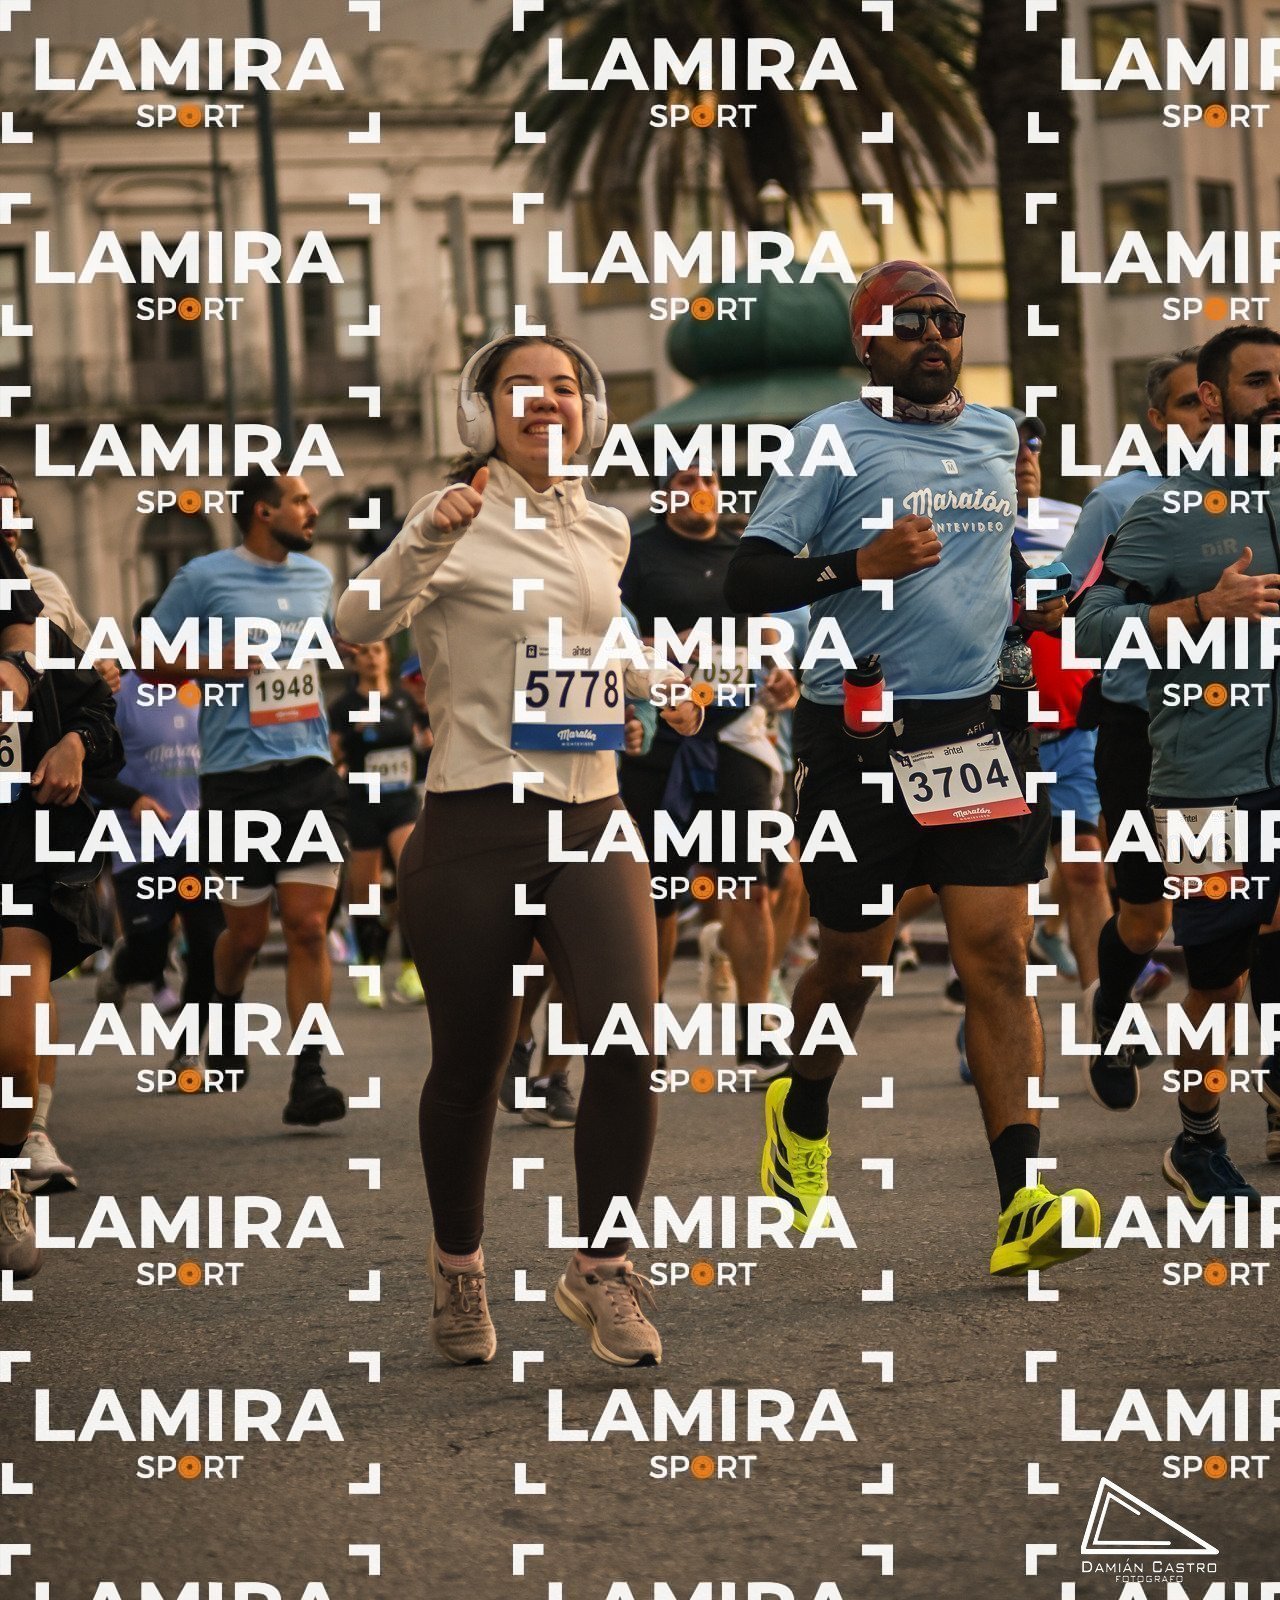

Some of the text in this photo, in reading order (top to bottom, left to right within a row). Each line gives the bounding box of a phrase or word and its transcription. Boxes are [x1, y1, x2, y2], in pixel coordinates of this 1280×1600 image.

[902, 487, 1012, 519] Maratón
[930, 521, 1004, 533] NTEVIDEO
[255, 674, 314, 702] 1948
[526, 670, 619, 708] 5778
[908, 758, 1009, 802] 3704
[952, 807, 992, 818] Maratón
